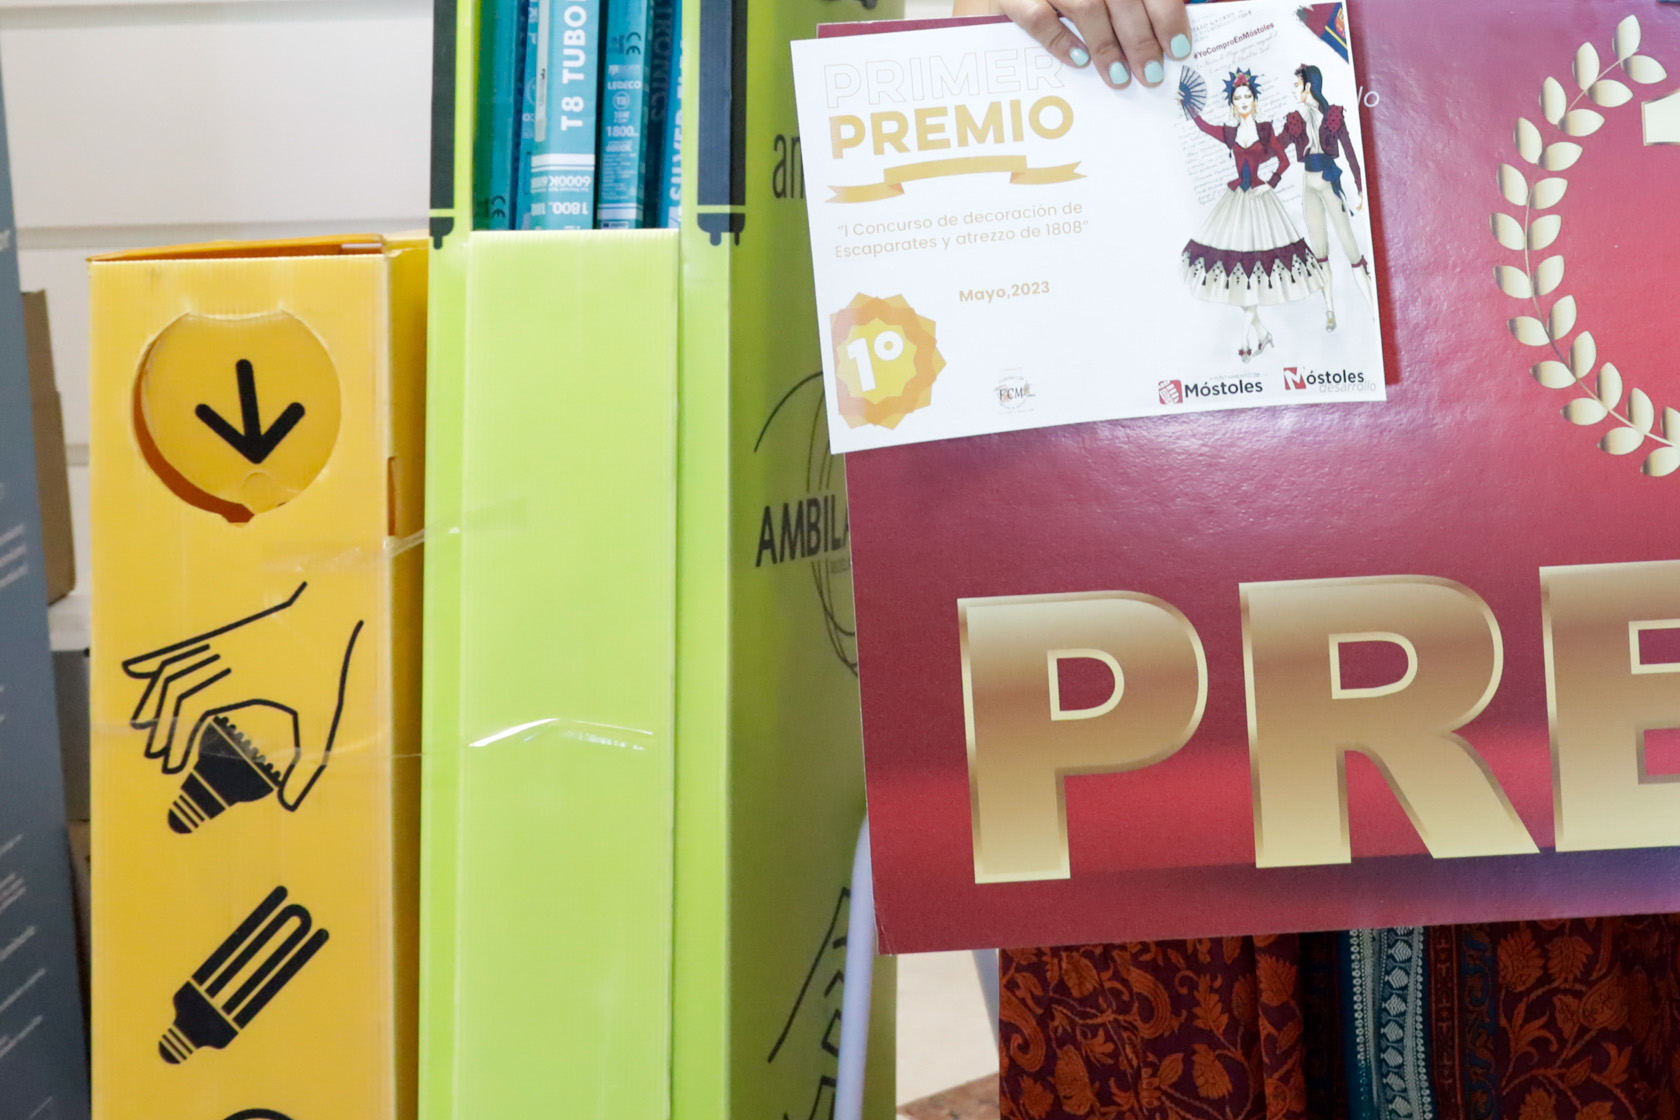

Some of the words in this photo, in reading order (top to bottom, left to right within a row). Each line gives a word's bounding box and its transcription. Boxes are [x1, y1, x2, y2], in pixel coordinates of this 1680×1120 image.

[1193, 22, 1275, 60] #YoComproEnMóstoles
[607, 80, 642, 90] LEDECO
[824, 46, 1065, 109] PRIMER
[560, 95, 585, 132] T8
[829, 95, 1075, 160] PREMIO
[853, 217, 933, 237] Concurso
[937, 214, 959, 227] de
[963, 203, 1058, 225] decoración
[1062, 202, 1084, 215] de
[834, 234, 938, 259] Escaparates
[941, 237, 951, 250] y
[955, 228, 1016, 246] atrezzo
[1020, 225, 1041, 239] de
[958, 281, 1051, 304] Mayo,2023
[1184, 378, 1264, 399] Móstoles
[1318, 380, 1378, 394] desarrollo
